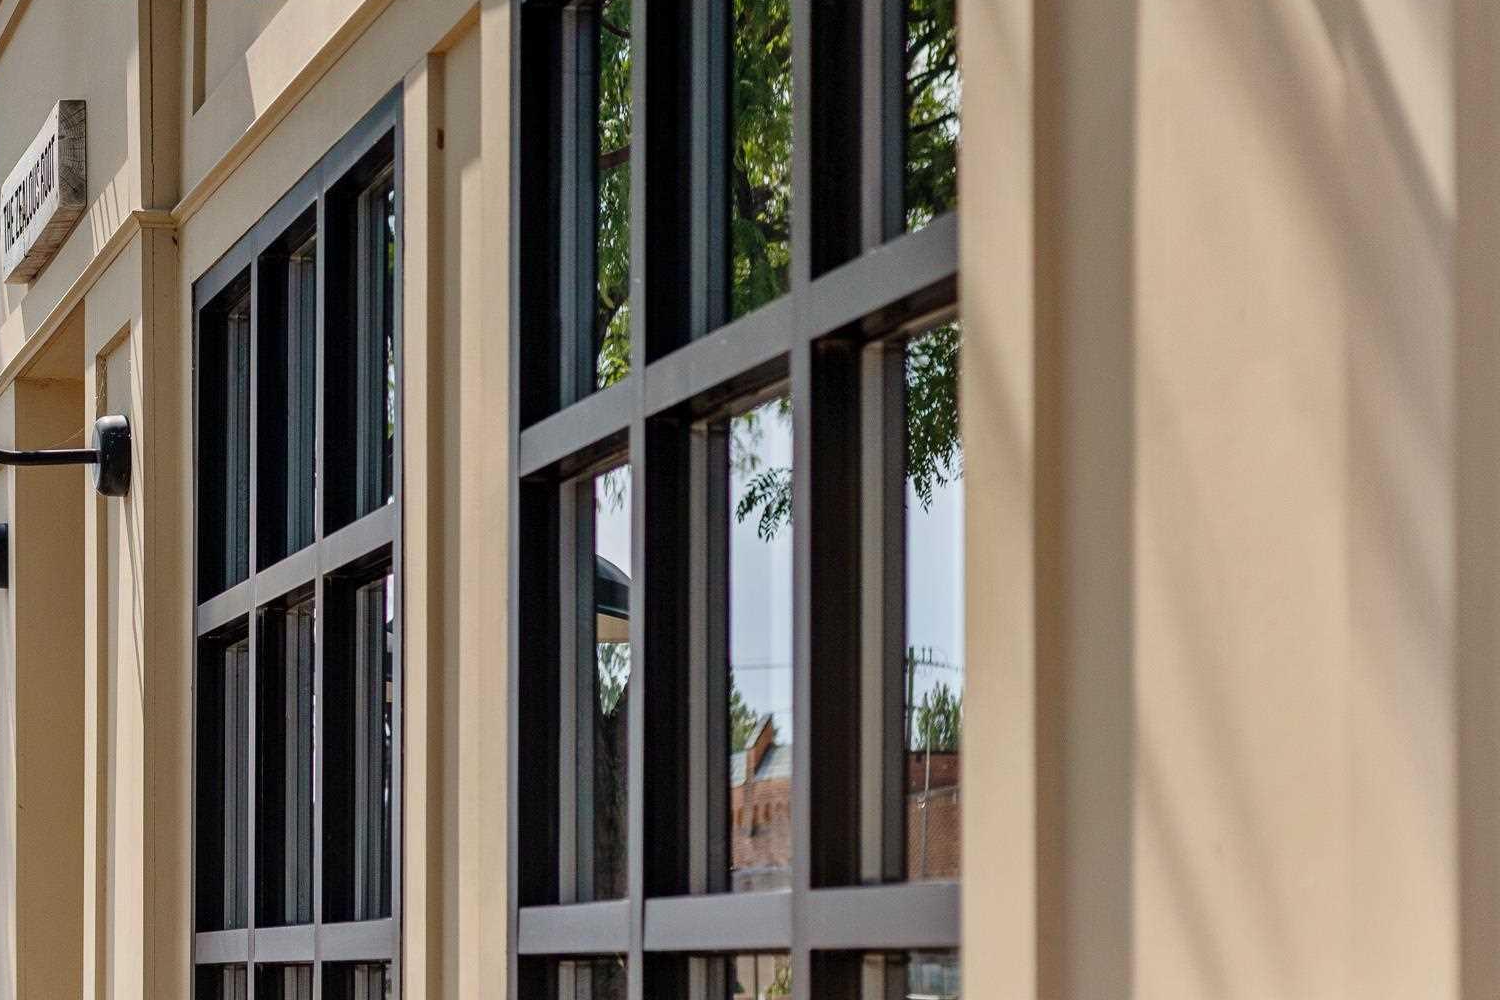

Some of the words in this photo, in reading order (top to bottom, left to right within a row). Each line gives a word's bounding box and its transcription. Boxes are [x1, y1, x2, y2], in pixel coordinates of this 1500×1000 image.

[3, 194, 15, 255] THE
[15, 159, 40, 239] ZEALOUS
[40, 133, 55, 206] ROOT
